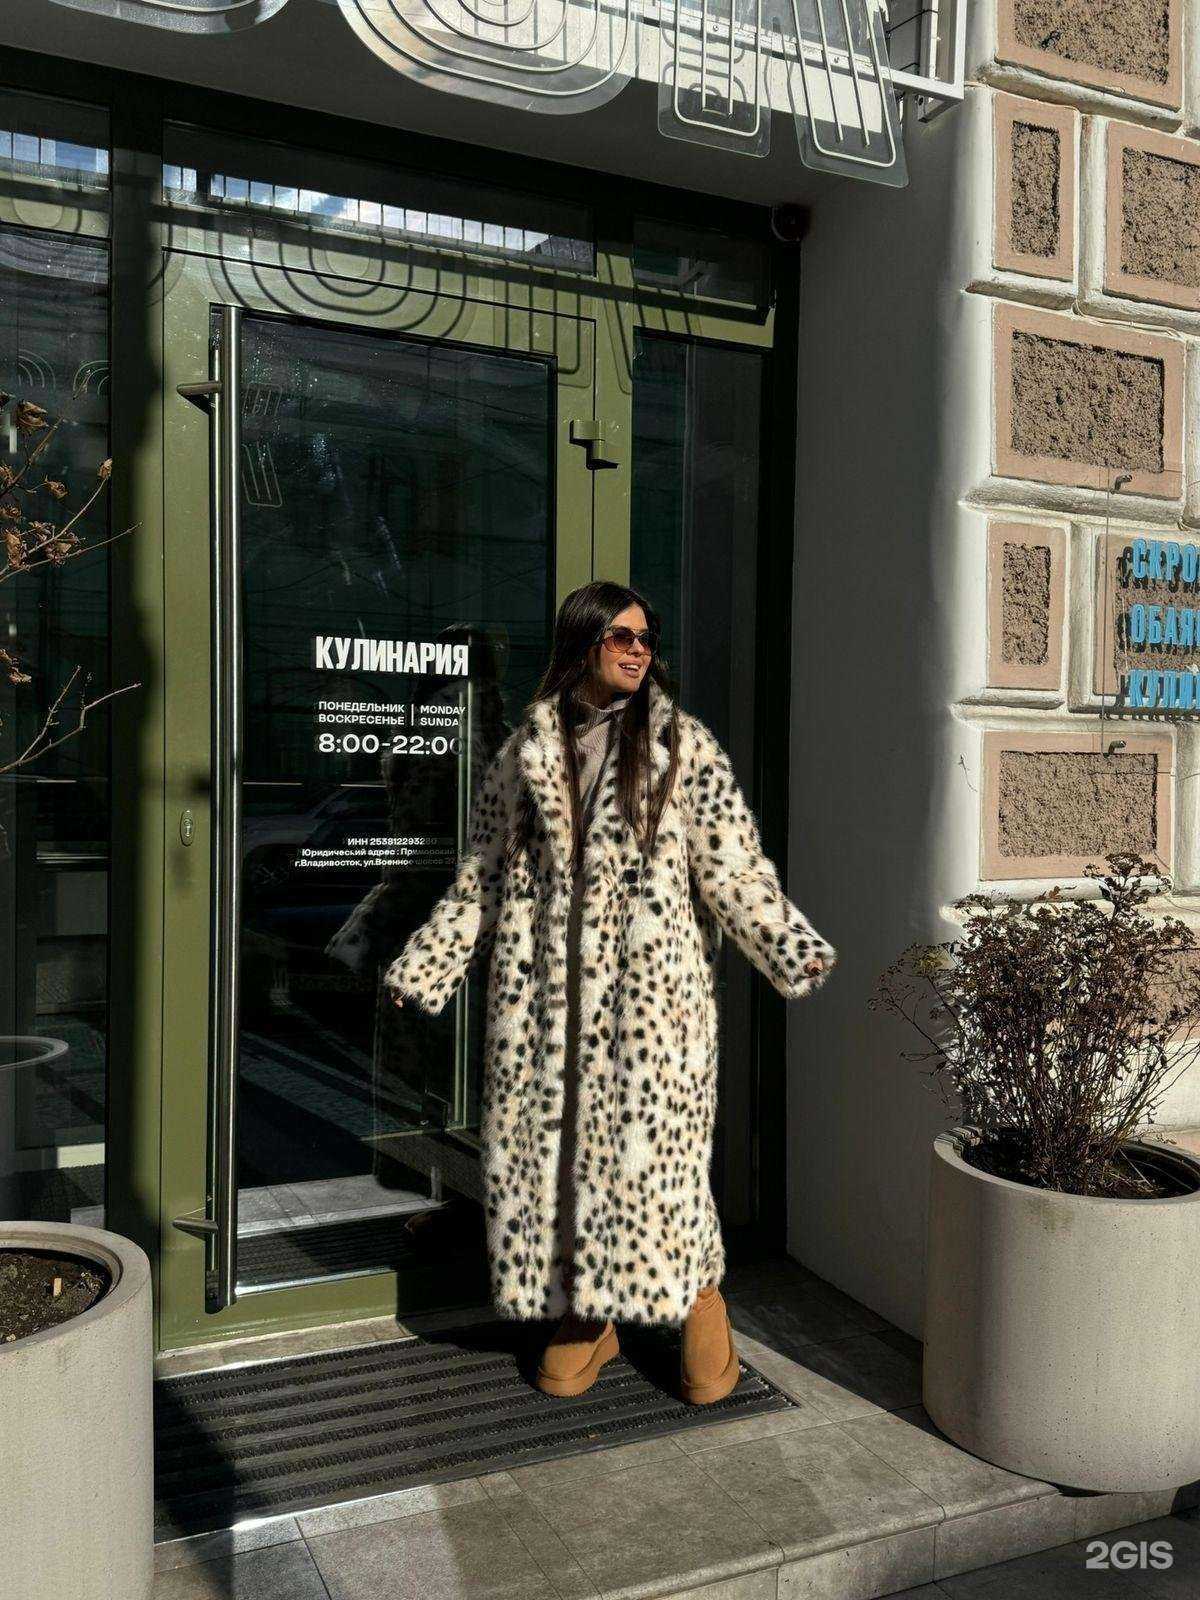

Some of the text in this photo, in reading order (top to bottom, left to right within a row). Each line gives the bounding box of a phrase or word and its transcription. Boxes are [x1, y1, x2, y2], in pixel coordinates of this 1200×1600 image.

[1132, 538, 1200, 583] СКРО
[1131, 604, 1200, 646] ОБАЯ
[315, 636, 469, 676] КУЛИНАРИЯ
[1129, 669, 1200, 709] КУЛИ
[318, 701, 405, 713] ПОНЕДЕЛЬНИК
[420, 704, 466, 715] MONDAY
[318, 714, 405, 725] ВОСКРЕСЕНЬЕ
[420, 717, 461, 727] SUNDA
[347, 838, 368, 846] ИНН
[302, 848, 367, 858] Юридический
